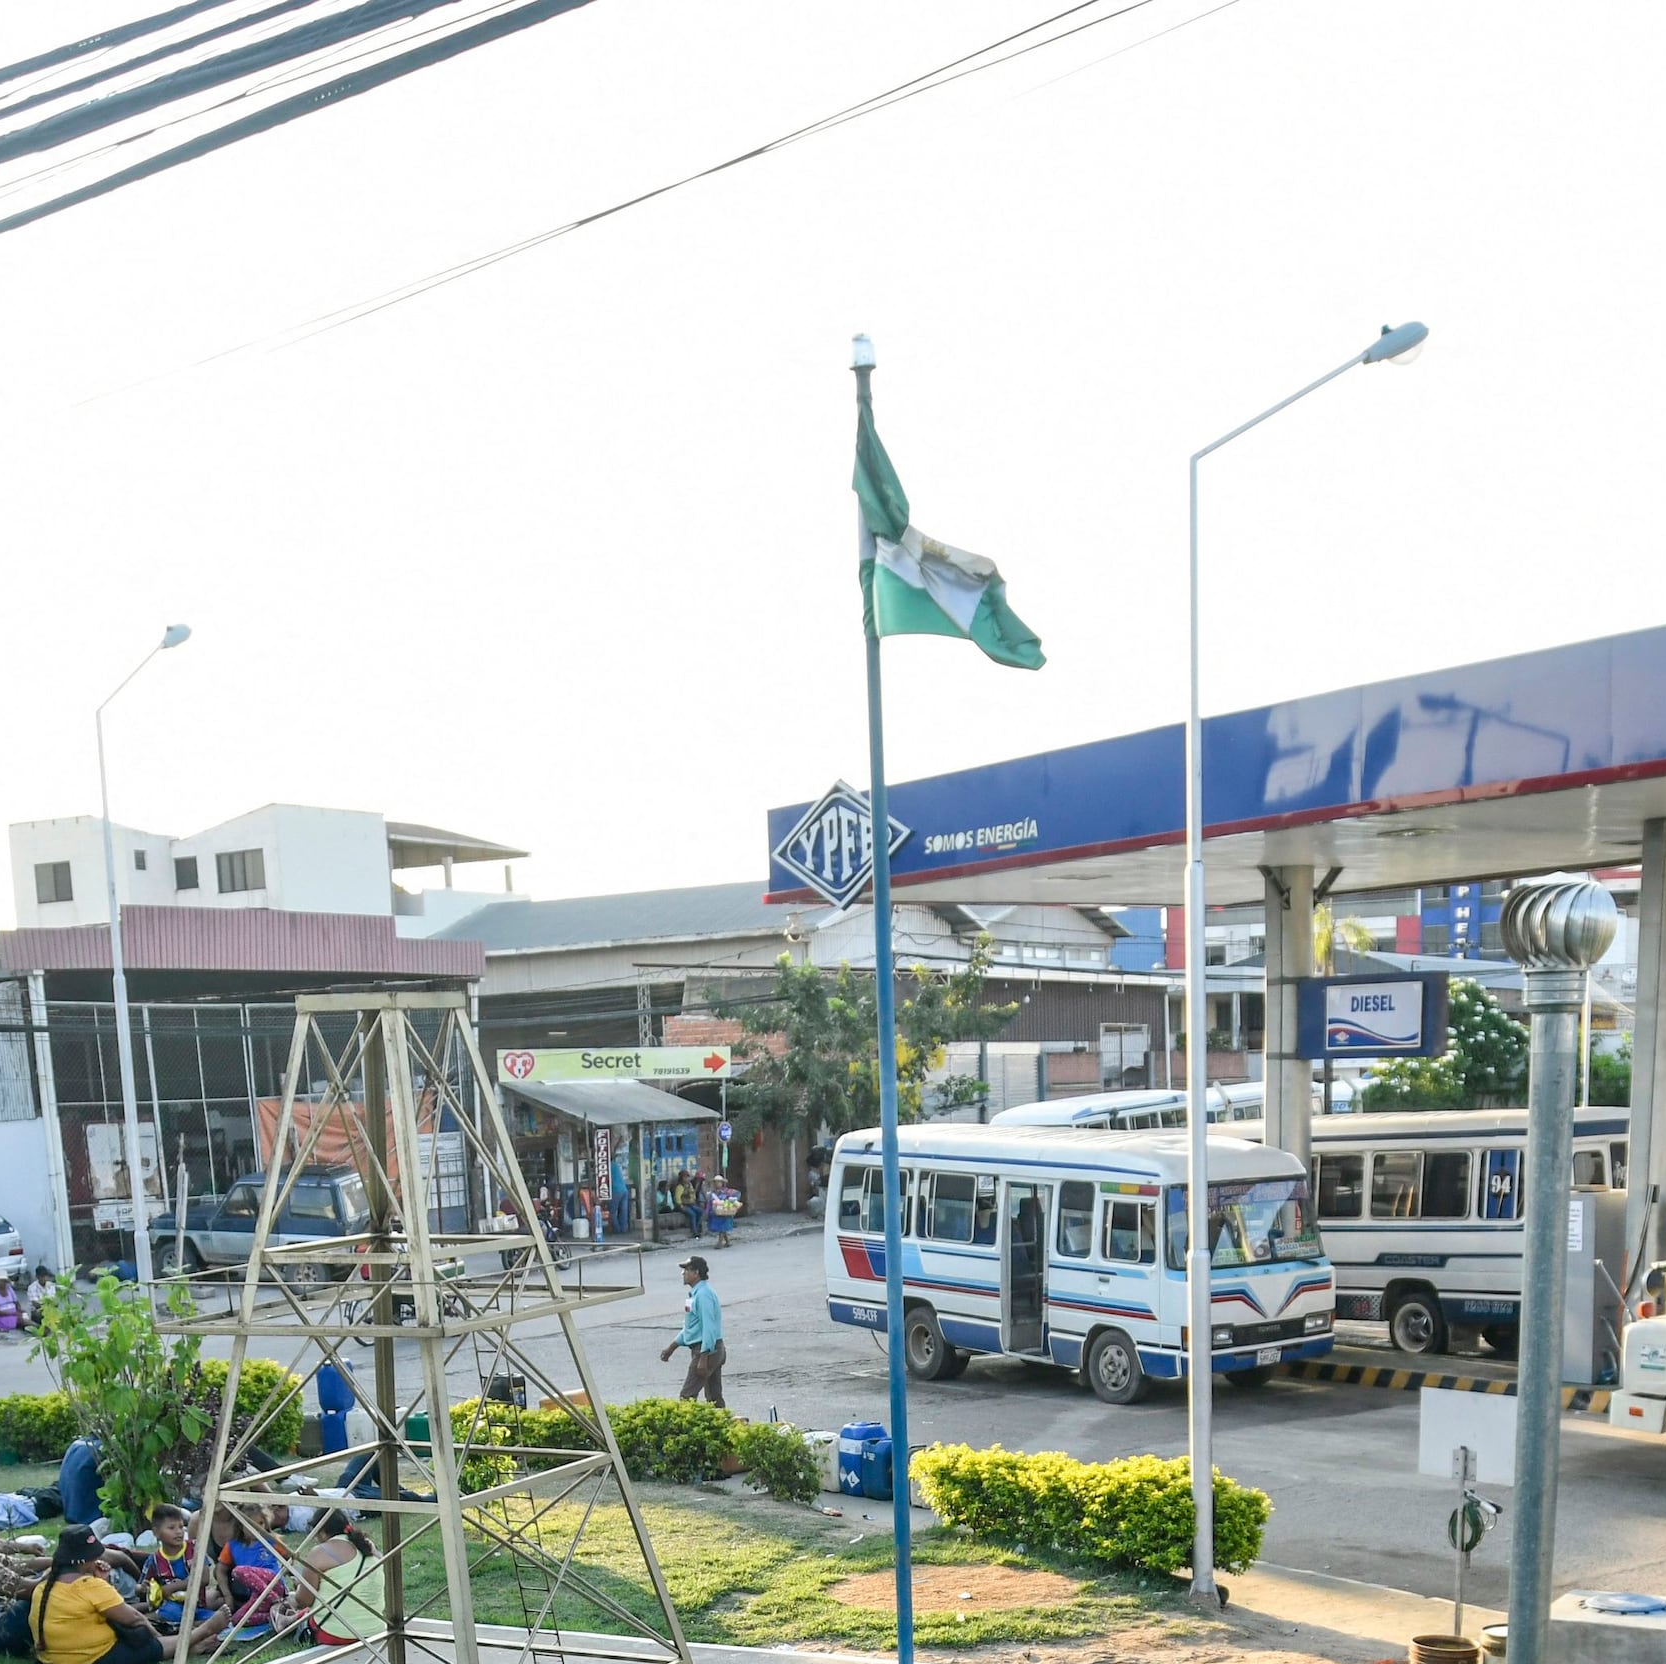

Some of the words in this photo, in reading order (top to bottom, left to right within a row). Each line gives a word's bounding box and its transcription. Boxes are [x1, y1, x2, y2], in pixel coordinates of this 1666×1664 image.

[924, 830, 974, 855] SOMOS
[976, 816, 1039, 845] ENERGÍA
[1350, 993, 1396, 1013] DIESEL
[581, 1052, 642, 1069] Secret
[596, 1130, 610, 1199] FOTOCOPIAS
[1491, 1174, 1512, 1193] 94
[1384, 1255, 1441, 1265] COASTER
